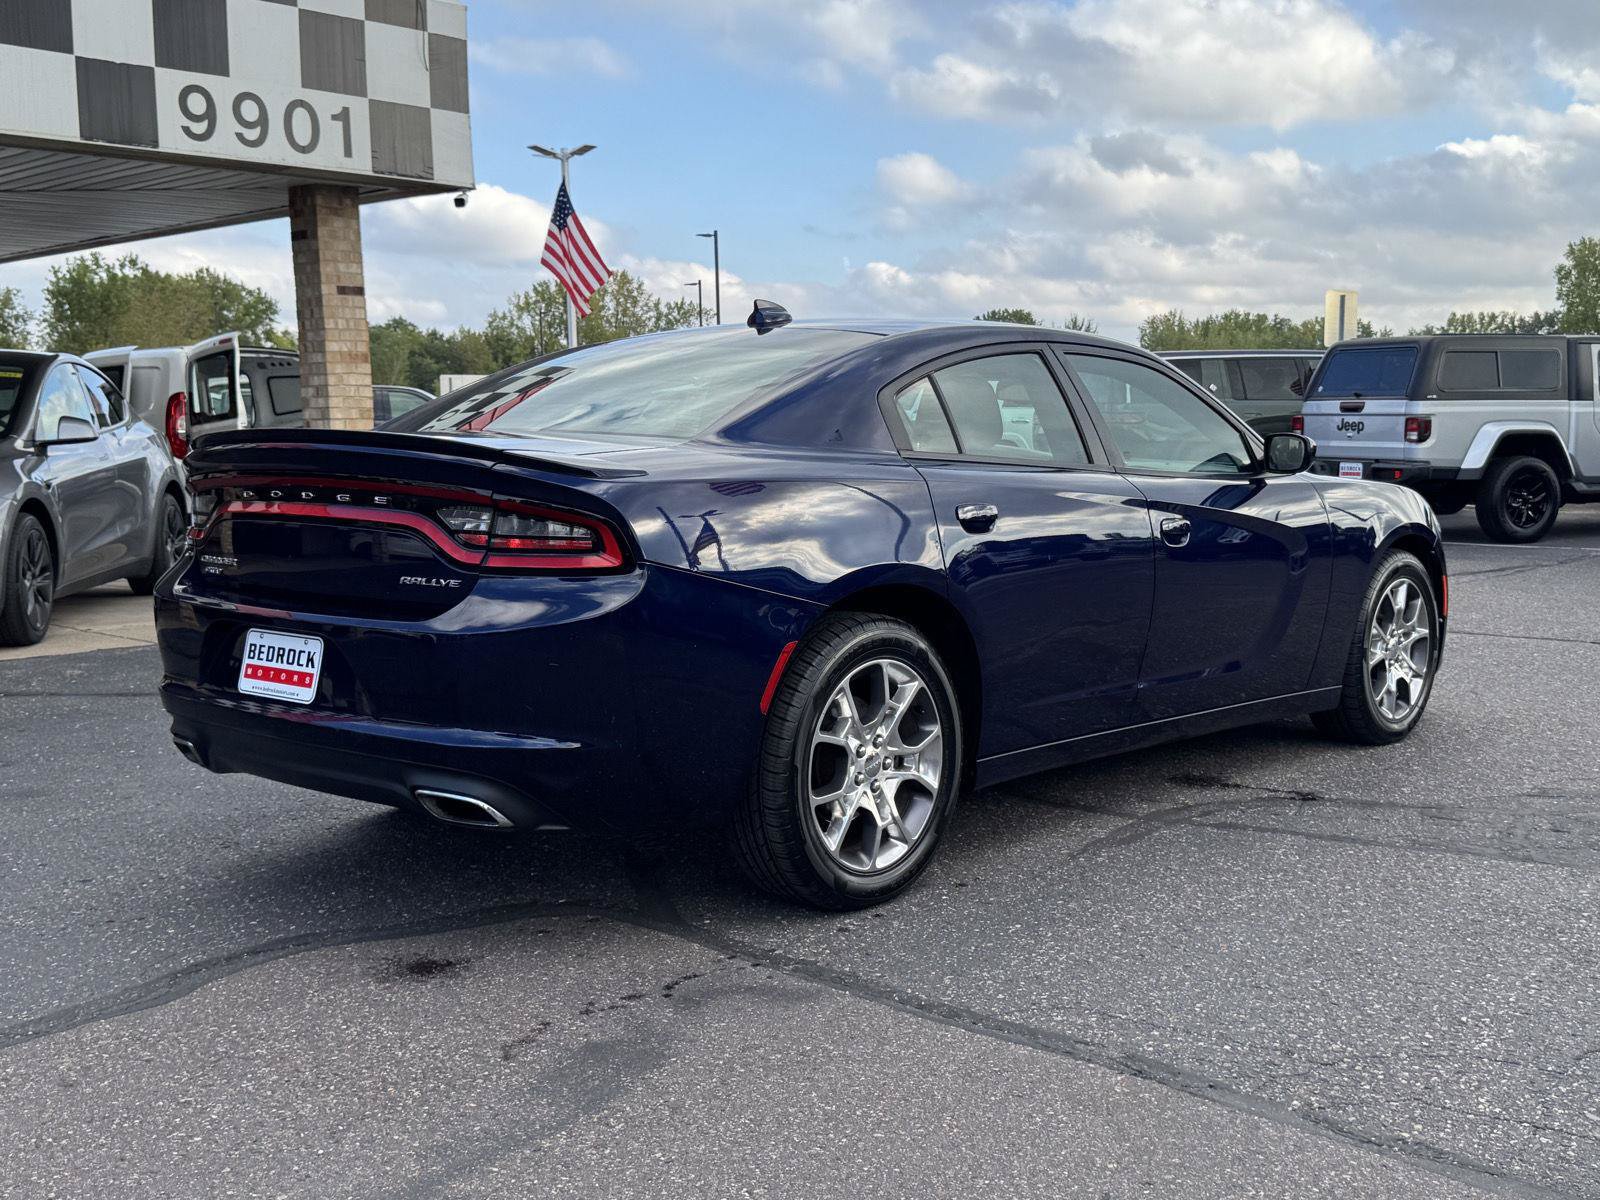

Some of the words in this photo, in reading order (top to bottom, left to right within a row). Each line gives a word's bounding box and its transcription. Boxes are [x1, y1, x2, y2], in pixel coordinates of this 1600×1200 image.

[178, 84, 353, 158] 9901
[1337, 418, 1365, 434] Jeep
[243, 490, 388, 504] DODGE
[399, 576, 462, 588] RALLYE
[247, 643, 317, 669] BEDROCK
[246, 667, 311, 685] MOTORS
